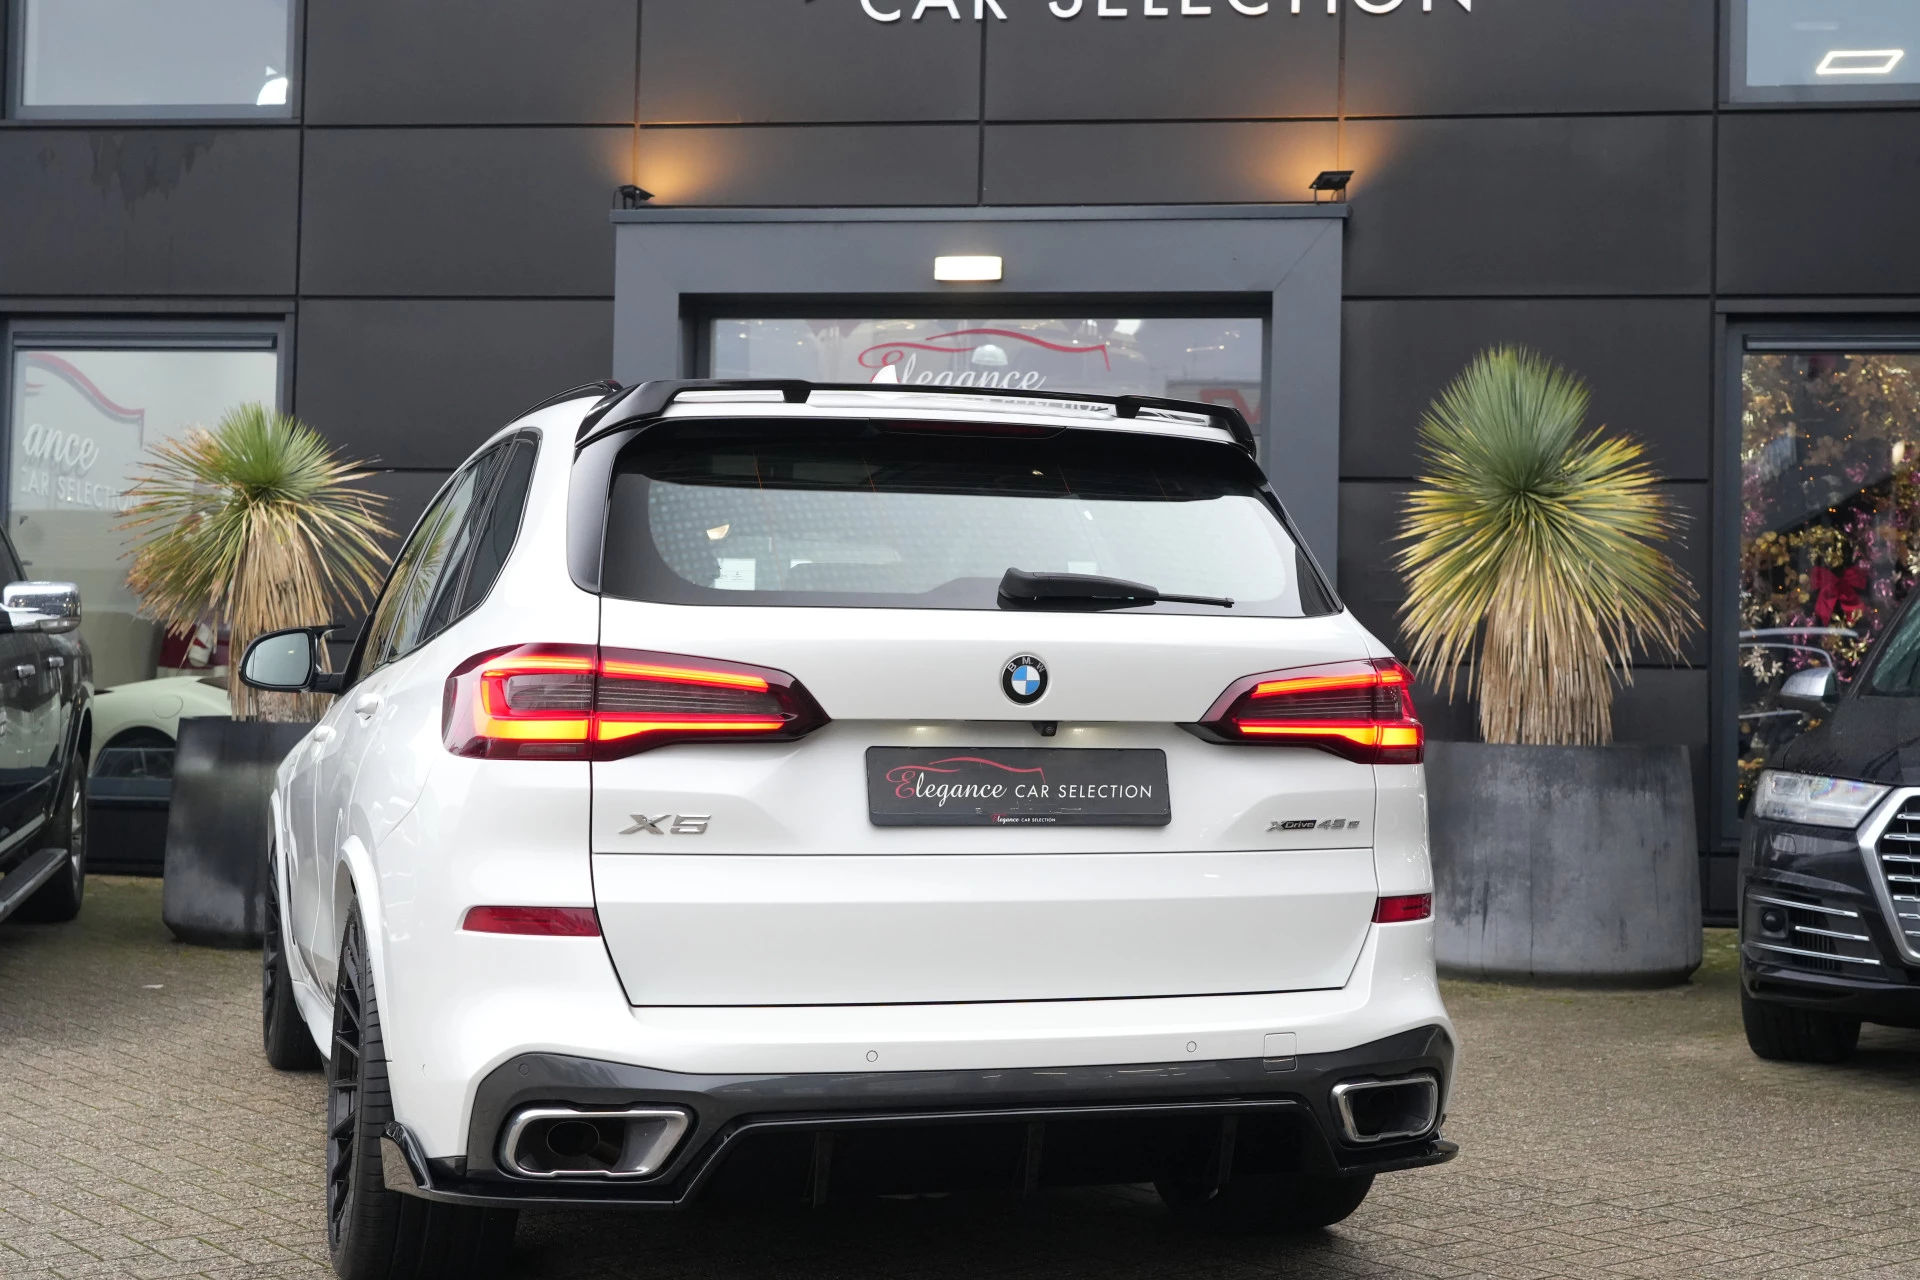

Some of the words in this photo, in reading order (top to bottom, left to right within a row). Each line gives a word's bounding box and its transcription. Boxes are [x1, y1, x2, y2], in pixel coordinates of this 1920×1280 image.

[1007, 656, 1046, 673] BMW
[886, 765, 1007, 808] Elegance
[1014, 784, 1050, 798] CAR
[1058, 784, 1152, 798] SELECTION
[618, 814, 711, 835] X5
